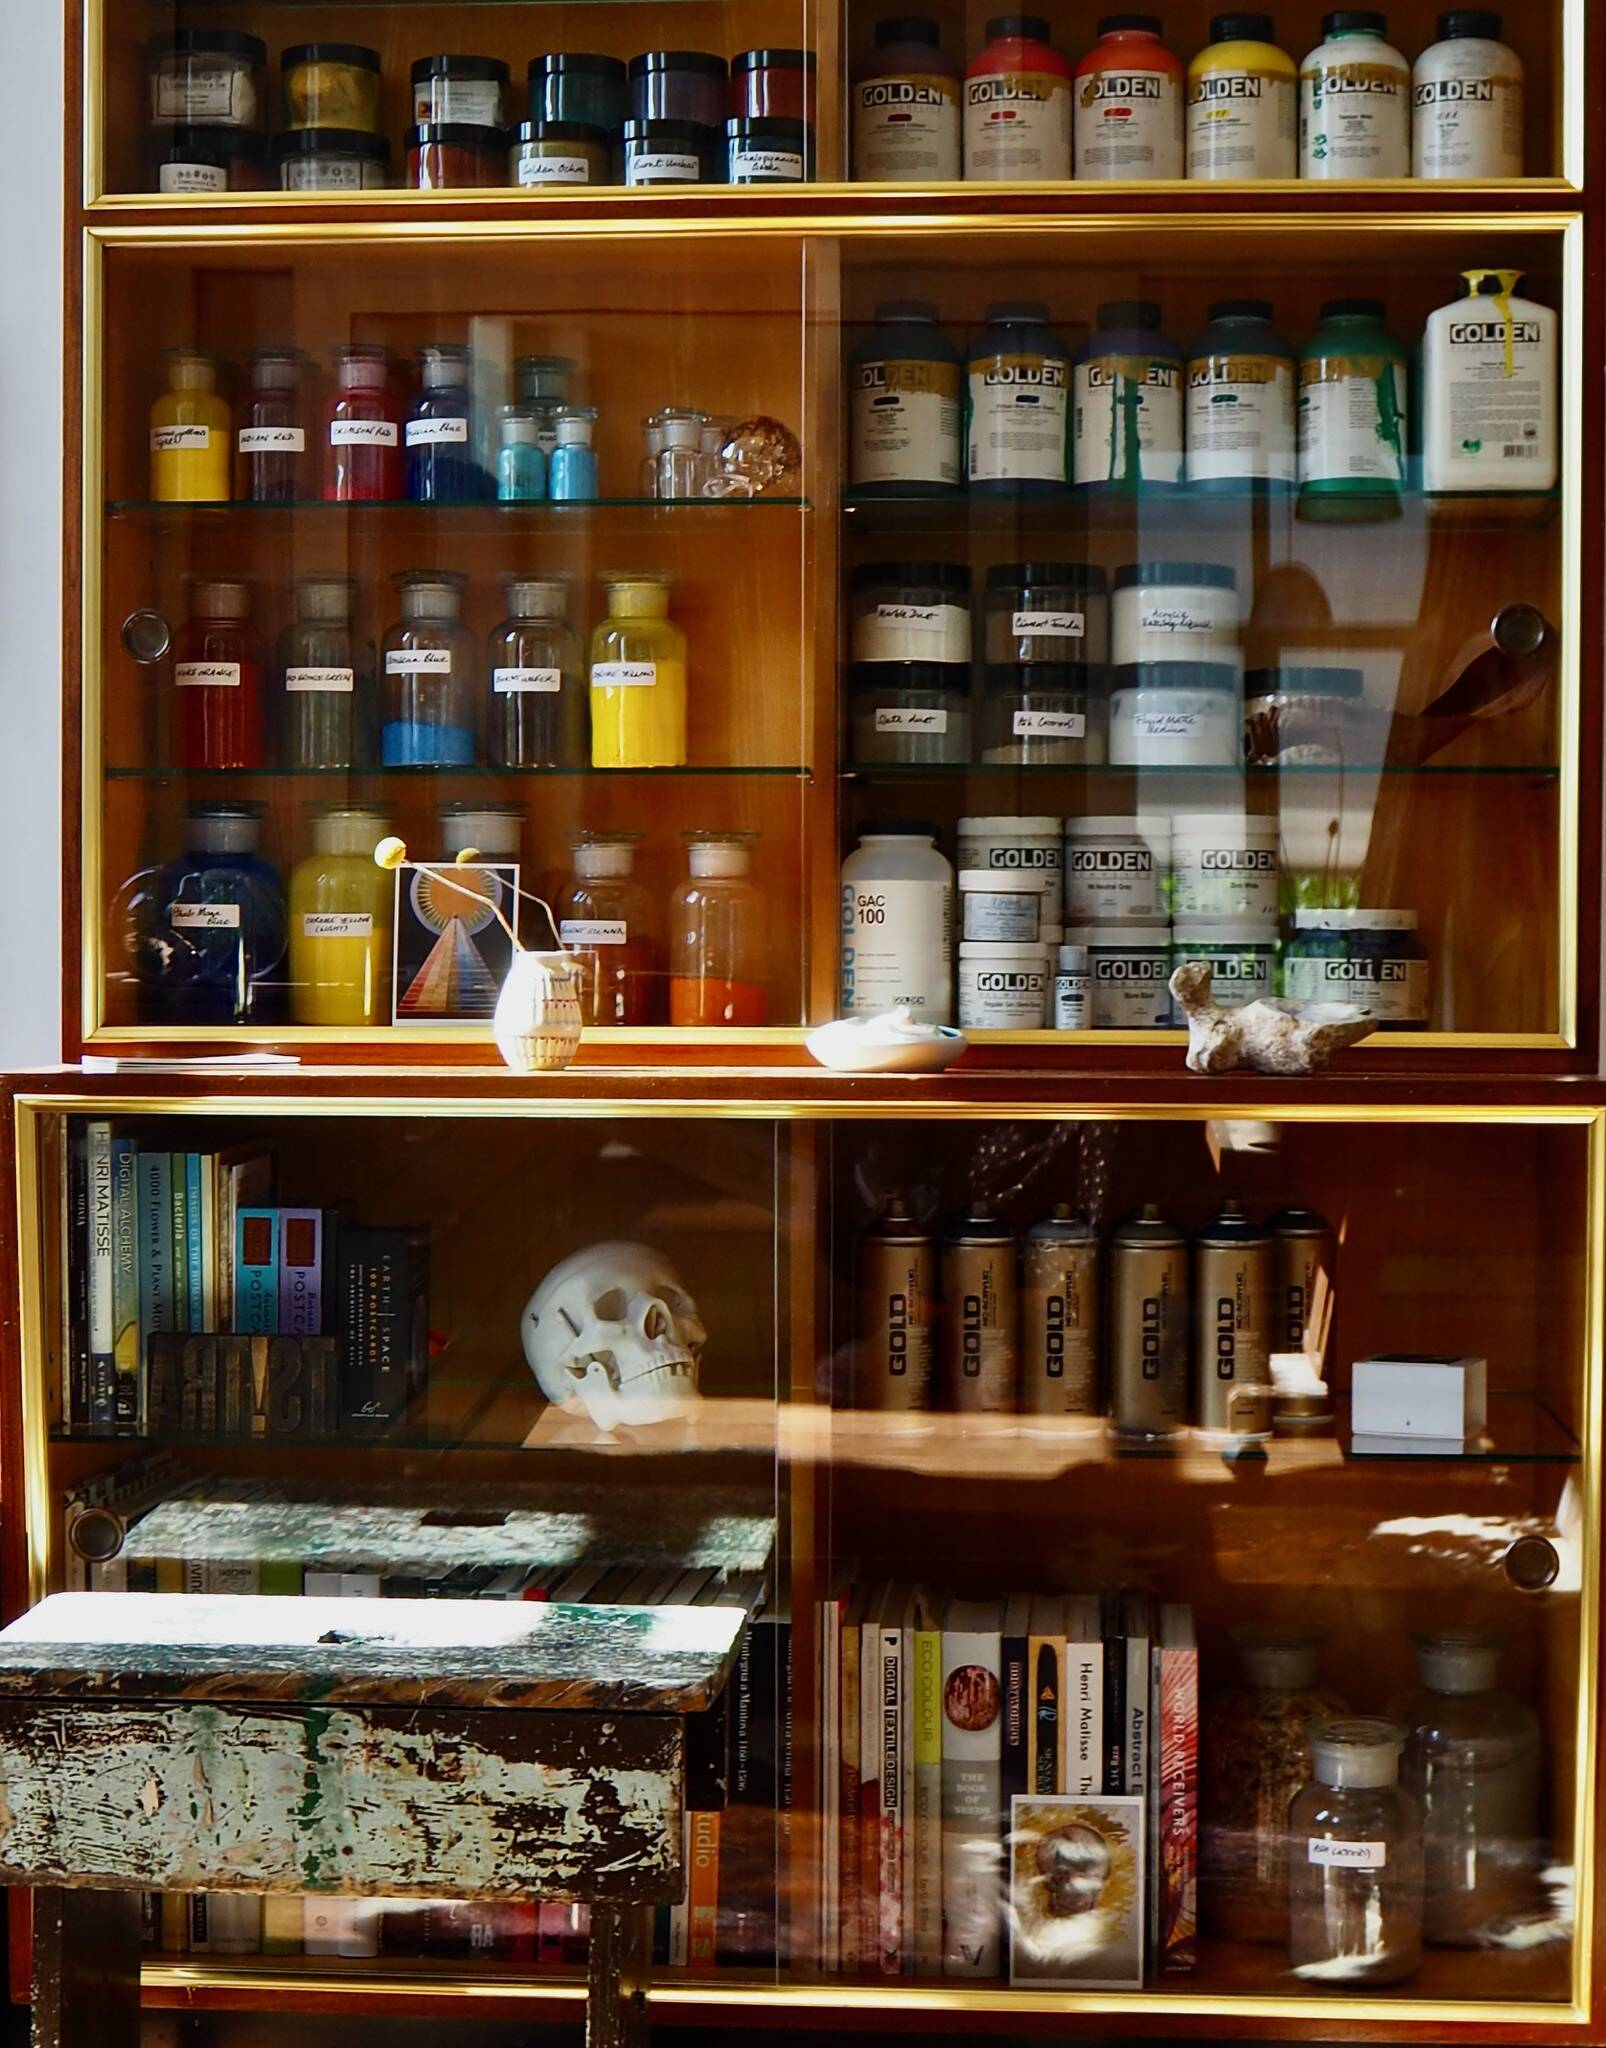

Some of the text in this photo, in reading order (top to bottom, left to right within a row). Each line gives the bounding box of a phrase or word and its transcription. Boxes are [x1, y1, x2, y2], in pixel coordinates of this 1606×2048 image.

[863, 84, 942, 105] GOLDEN
[969, 80, 1046, 104] GOLDE
[1087, 77, 1160, 100] OLDEN
[1194, 77, 1260, 103] OLDEN
[1452, 323, 1540, 343] GOLDEN
[862, 366, 929, 388] OLDEN
[986, 366, 1064, 386] GOLDEN
[991, 849, 1059, 868] GOLDE
[1073, 852, 1150, 871] GOLDEN
[1202, 850, 1276, 869] GOLDEN
[857, 895, 886, 908] GAC
[857, 908, 886, 924] 100
[843, 884, 855, 1009] GOLDEN
[1212, 962, 1266, 979] LDEN
[96, 1131, 110, 1257] HENRI MATISSE
[119, 1152, 132, 1203] DIGITAL
[150, 1165, 160, 1196] 4000
[173, 1192, 184, 1240] Bacteria
[190, 1229, 199, 1241] OF
[119, 1208, 132, 1273] ALCHEMY
[151, 1249, 162, 1258] &
[190, 1246, 199, 1265] THE
[152, 1263, 162, 1297] PLANT
[382, 1255, 390, 1304] EARTH
[889, 1294, 906, 1376] GOLD
[963, 1295, 980, 1378] GOLD
[1046, 1296, 1063, 1378] GOLD
[1287, 1285, 1304, 1346] OLD
[381, 1326, 390, 1374] SPACE
[1143, 1298, 1160, 1380] GOLD
[1217, 1298, 1234, 1380] GOLD
[884, 1656, 897, 1706] DIGITAL
[921, 1640, 933, 1742] ECO COLOUR
[1080, 1662, 1093, 1701] Henri
[884, 1710, 897, 1759] TEXTILE
[1080, 1707, 1093, 1762] Matisse
[1132, 1707, 1144, 1778] Abstract
[884, 1760, 897, 1807] DESIGN
[960, 1772, 985, 1783] THE
[1172, 1688, 1186, 1837] WORLD RECEIVERS
[964, 1795, 981, 1805] OF
[695, 1812, 711, 1869] tudio
